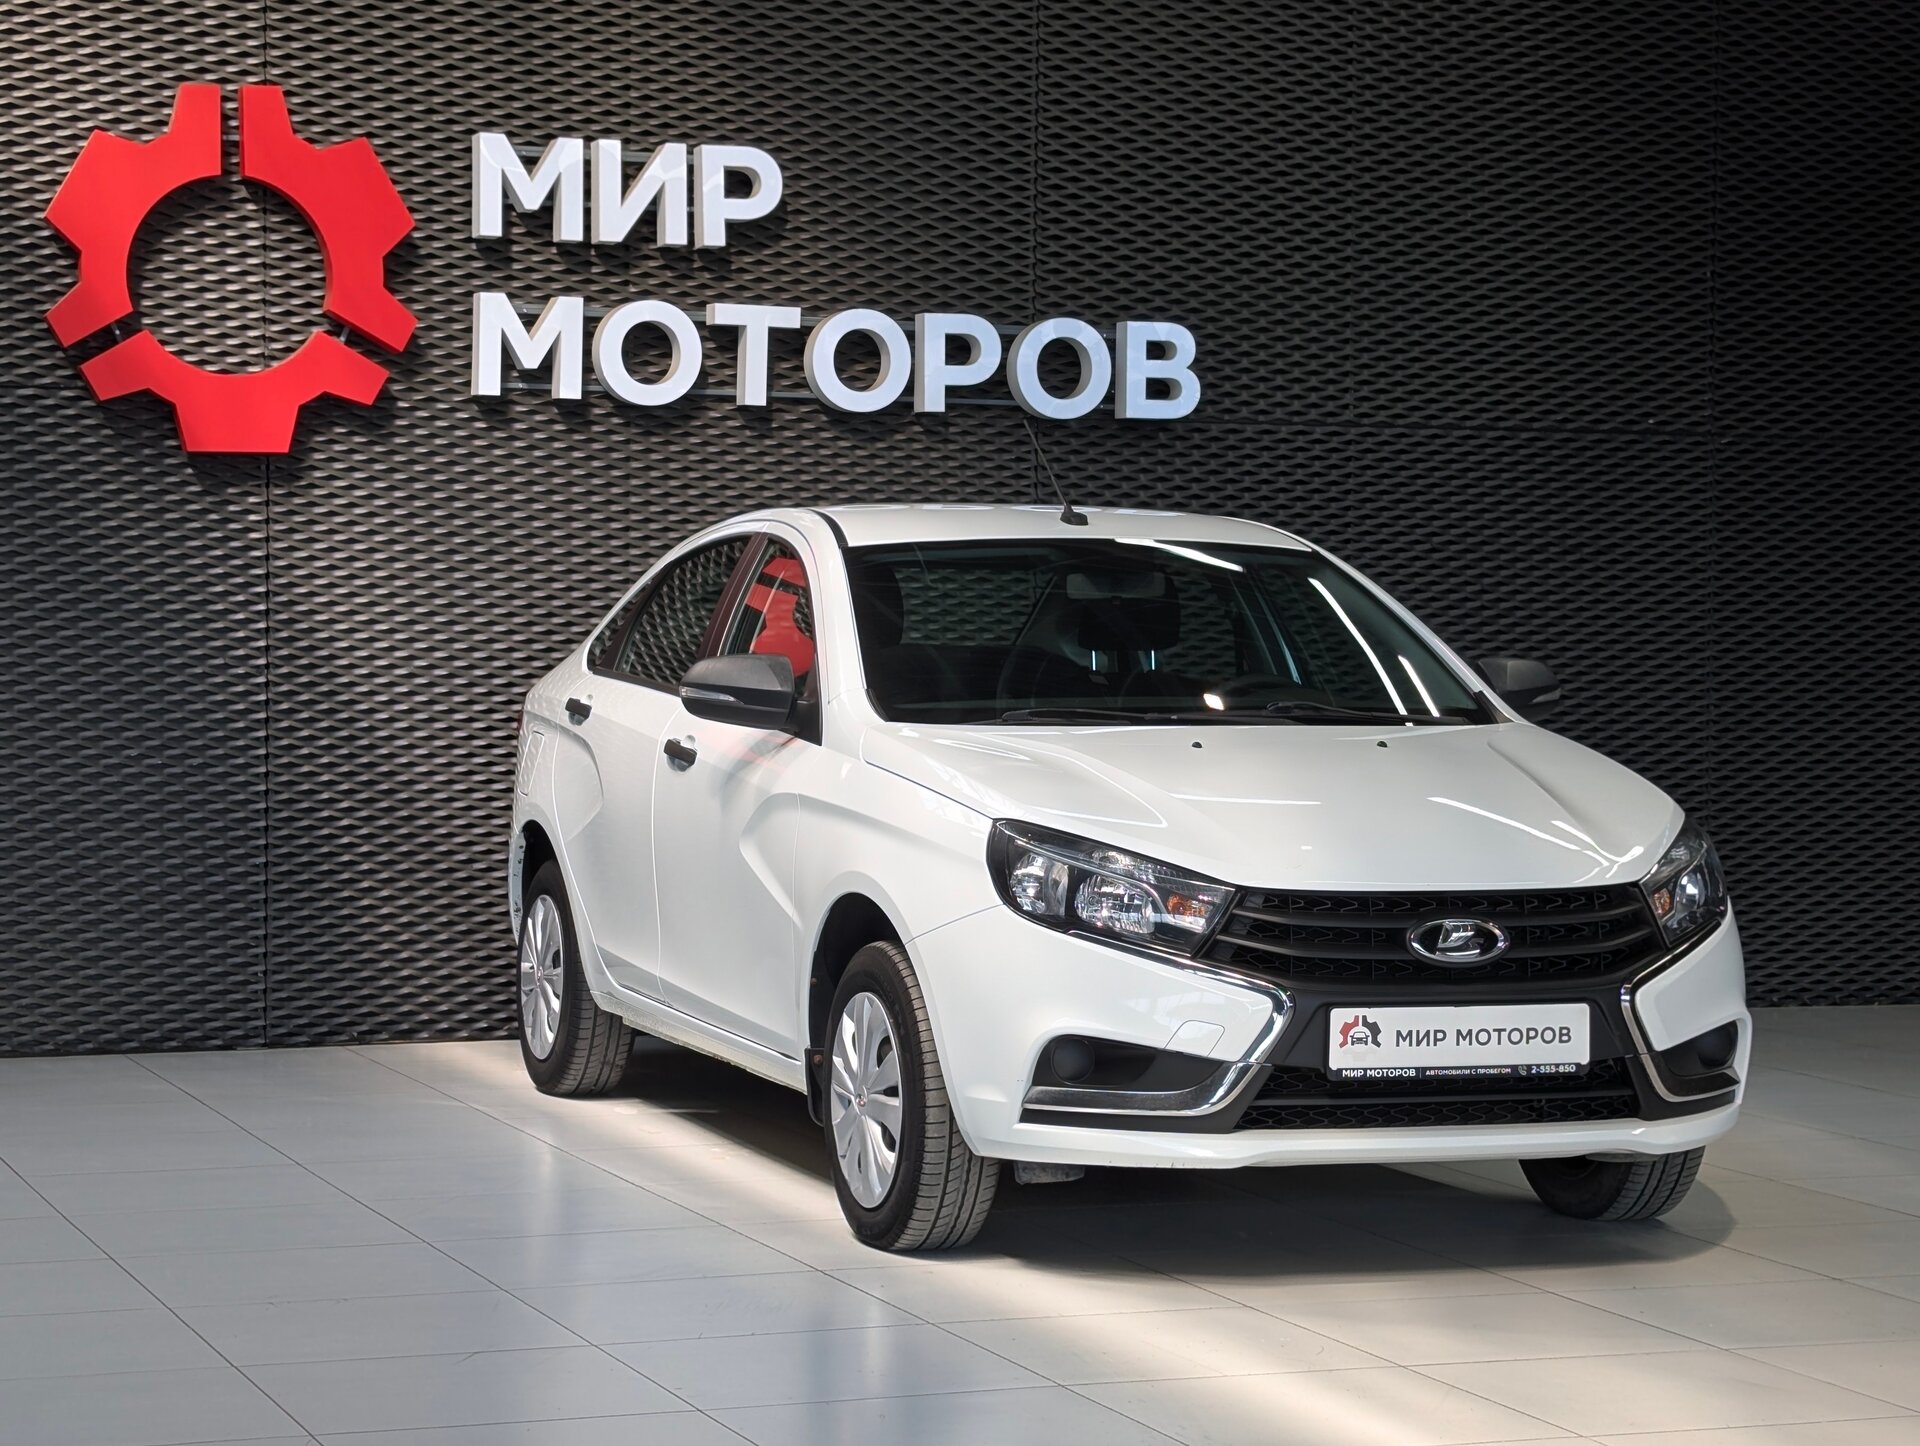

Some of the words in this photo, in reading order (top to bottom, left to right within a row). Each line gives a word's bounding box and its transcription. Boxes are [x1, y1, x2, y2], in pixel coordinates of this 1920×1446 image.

[471, 132, 783, 248] МИР
[471, 292, 1202, 420] МОТОРОВ
[1395, 1029, 1447, 1047] МИР
[1455, 1026, 1572, 1047] МОТОРОВ
[1342, 1069, 1364, 1078] МИР
[1366, 1068, 1416, 1077] МОТОРОВ
[1477, 1067, 1511, 1075] ПРОБЕГОМ
[1530, 1064, 1576, 1074] 2-555-850
